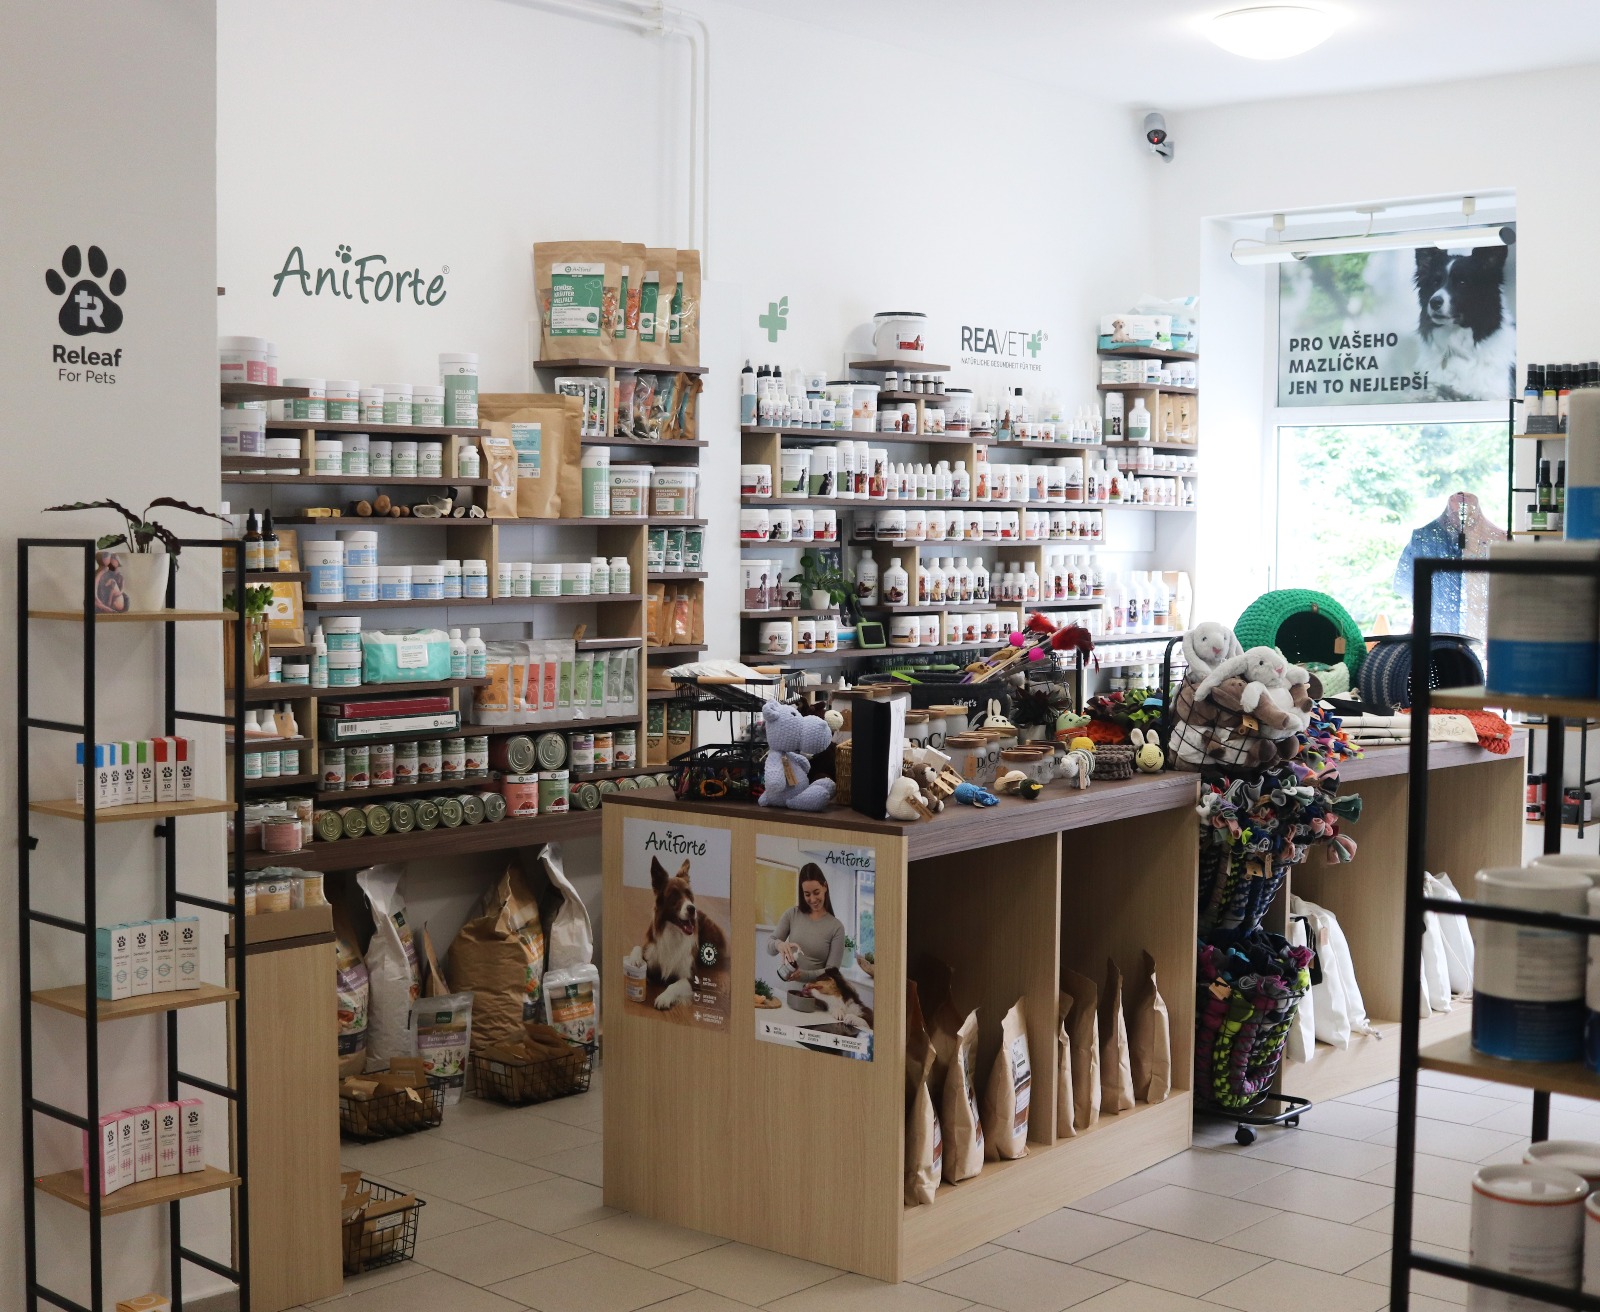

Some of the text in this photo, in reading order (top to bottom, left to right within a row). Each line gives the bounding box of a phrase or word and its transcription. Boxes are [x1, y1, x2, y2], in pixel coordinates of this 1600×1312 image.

[272, 245, 447, 306] AniForte
[961, 325, 1029, 357] REAVET
[1289, 330, 1399, 352] PRO VAŠEHO
[52, 344, 122, 367] Releaf
[990, 359, 1019, 370] GESUNDHEIT
[1029, 364, 1042, 372] TIERE
[1288, 352, 1379, 374] MAZLÍČKA
[58, 368, 116, 385] For Pets
[1288, 371, 1429, 395] JEN TO NEJLEPŠÍ
[645, 831, 707, 856] AniForte
[825, 850, 871, 868] AniForte
